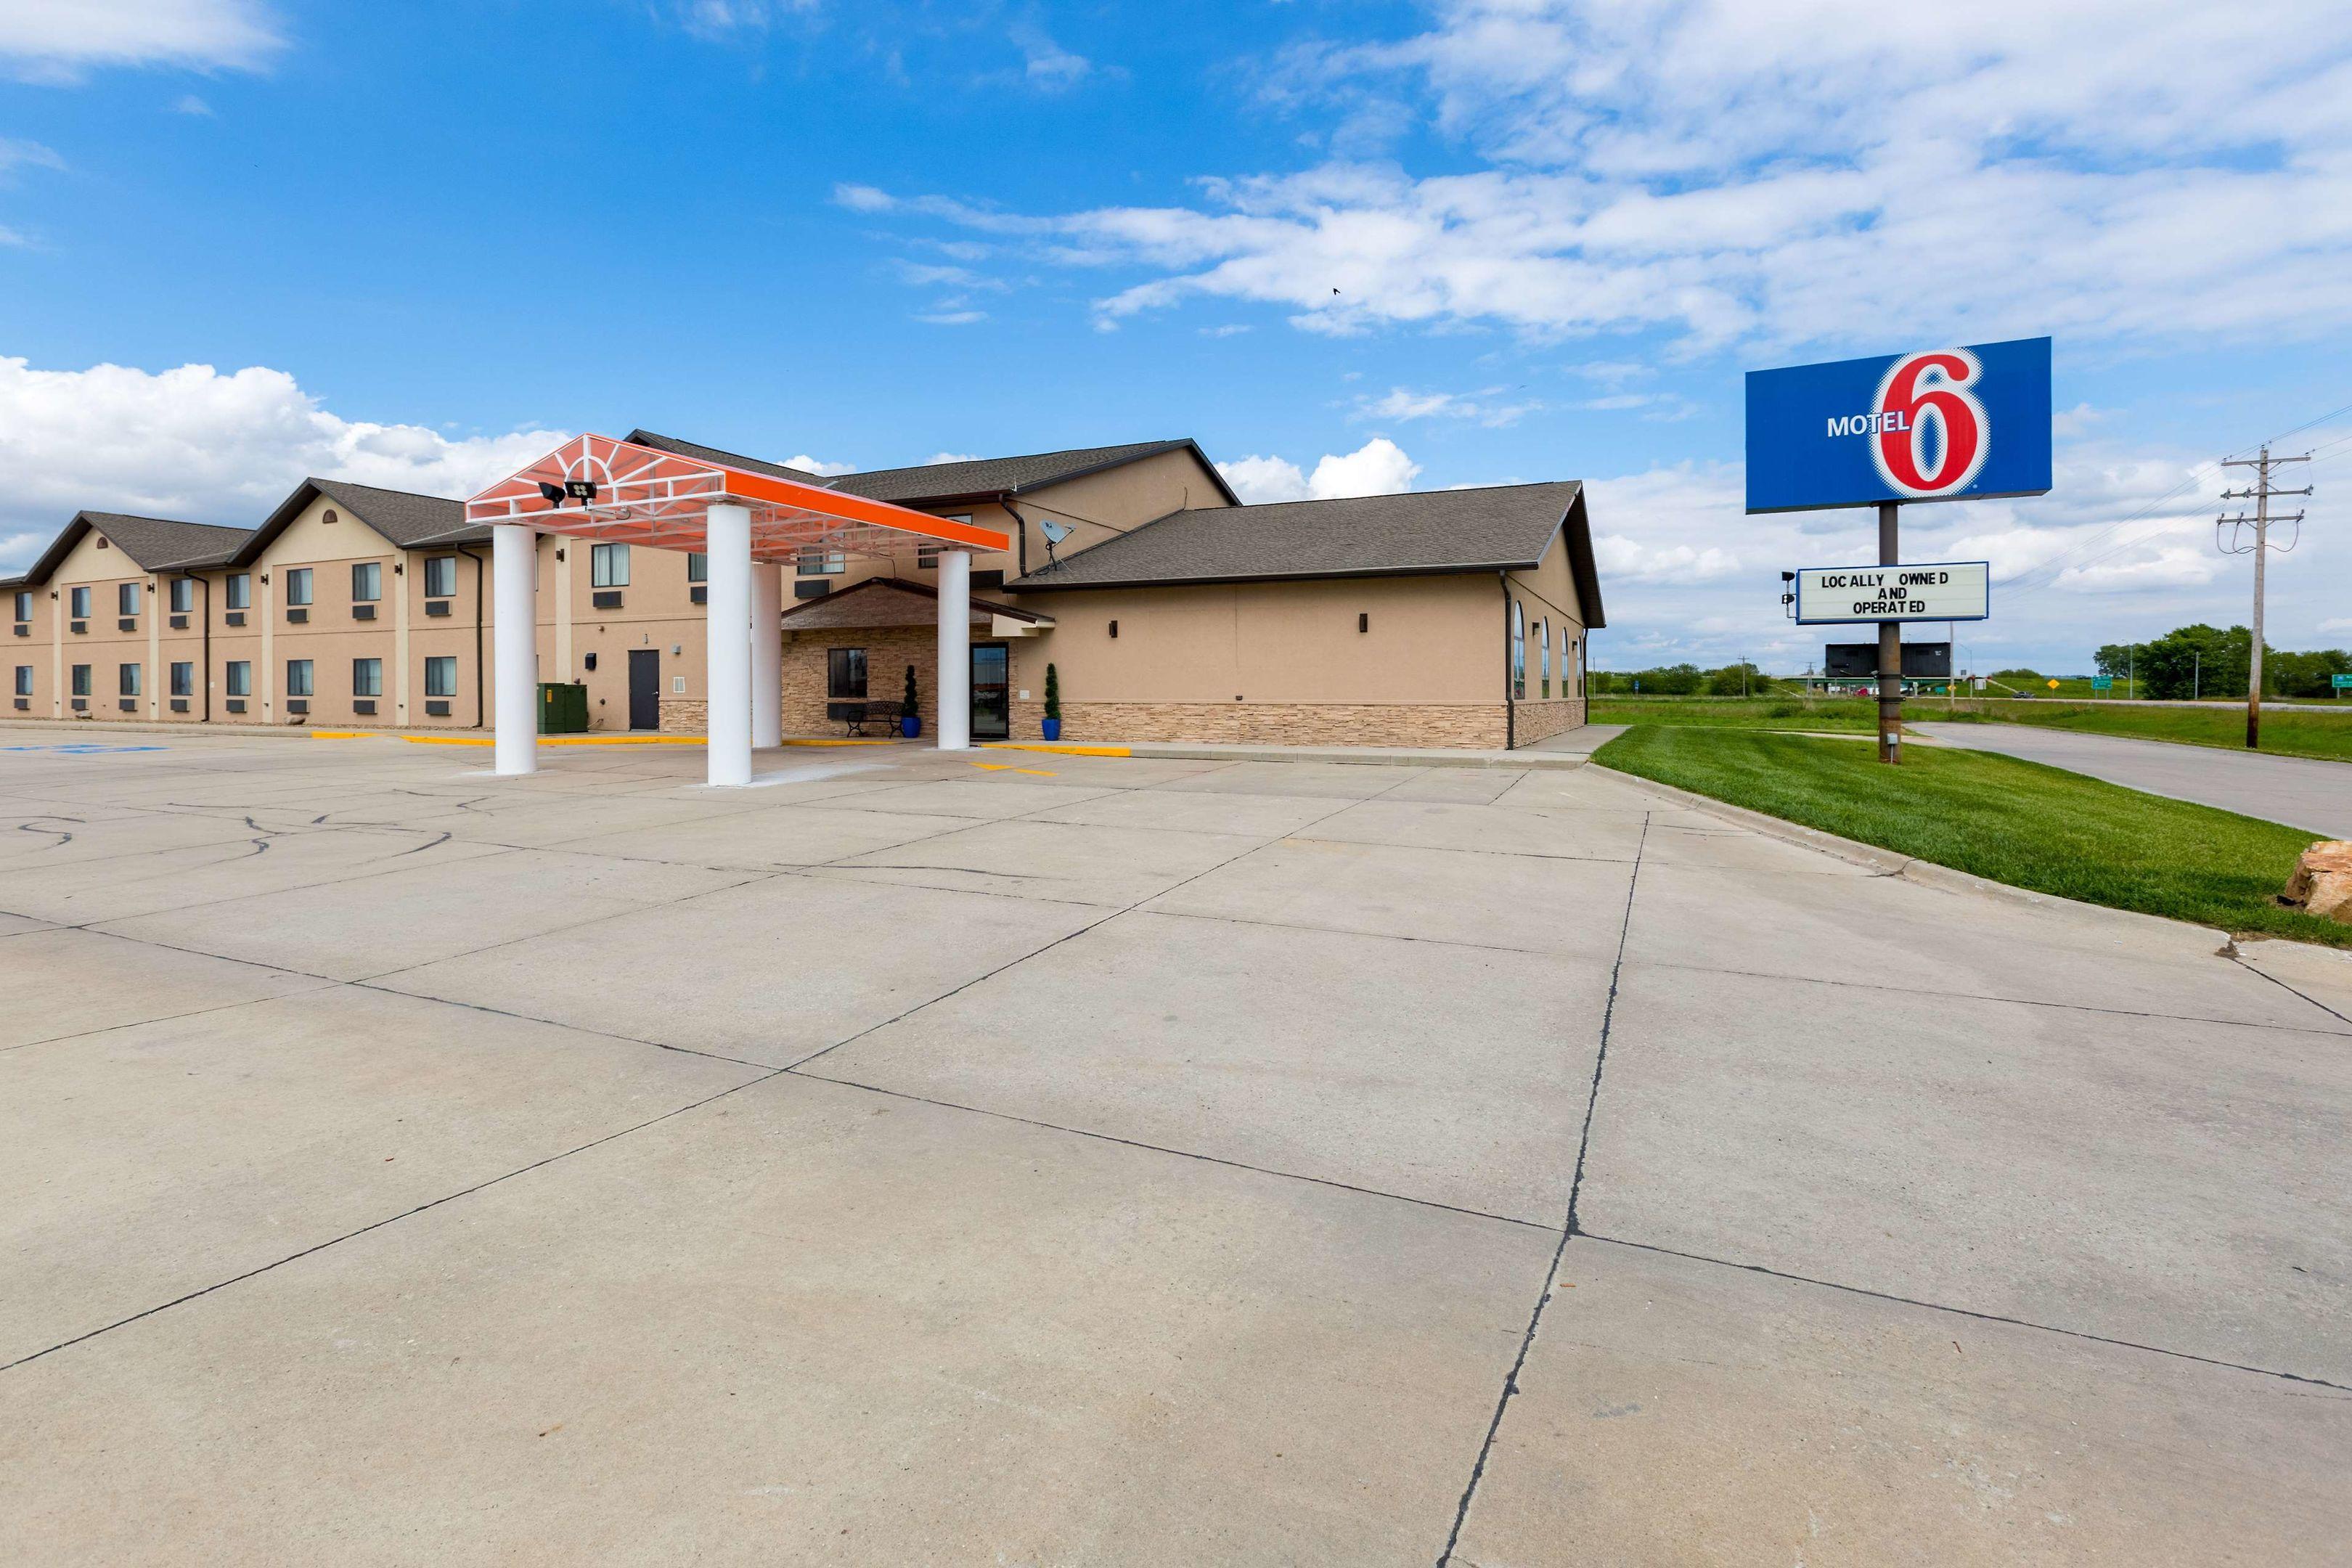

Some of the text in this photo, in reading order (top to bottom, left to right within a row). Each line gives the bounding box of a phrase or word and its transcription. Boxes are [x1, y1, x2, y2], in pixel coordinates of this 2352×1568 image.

[1827, 354, 1978, 491] MOTEL 6
[1821, 572, 1948, 587] LOCALLY OWNED
[1878, 587, 1907, 600] AND
[1853, 601, 1925, 614] OPERATED
